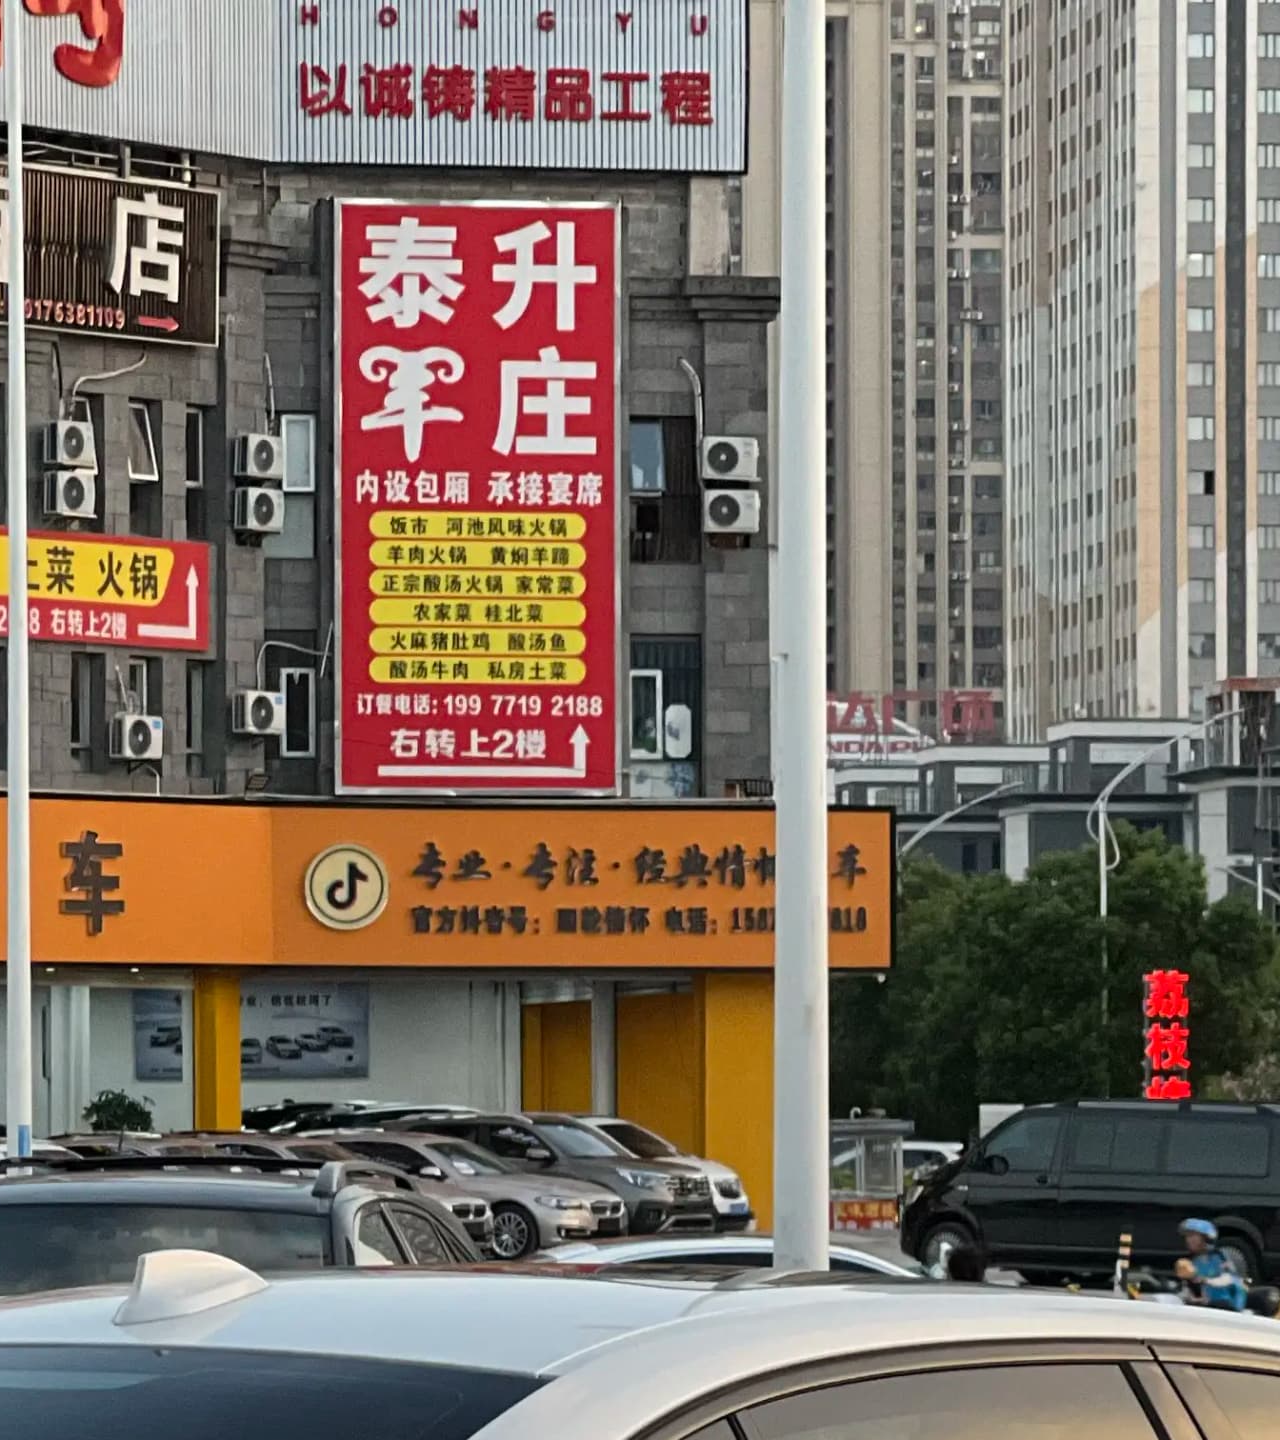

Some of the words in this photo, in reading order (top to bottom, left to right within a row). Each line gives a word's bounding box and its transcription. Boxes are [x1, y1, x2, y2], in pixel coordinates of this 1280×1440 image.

[299, 62, 713, 127] 以诚铸精品工程
[357, 216, 598, 332] 泰升
[355, 469, 470, 504] 内设包厢
[487, 471, 603, 506] 承接宴席
[386, 546, 467, 565] 羊肉火锅
[96, 550, 160, 601] 火锅
[381, 574, 503, 594] 正宗酸汤火锅
[515, 575, 575, 595] 家常菜
[413, 603, 472, 623] 农家菜
[491, 695, 543, 717] 7719
[550, 696, 604, 718] 2188
[390, 728, 547, 760] 右转上2楼
